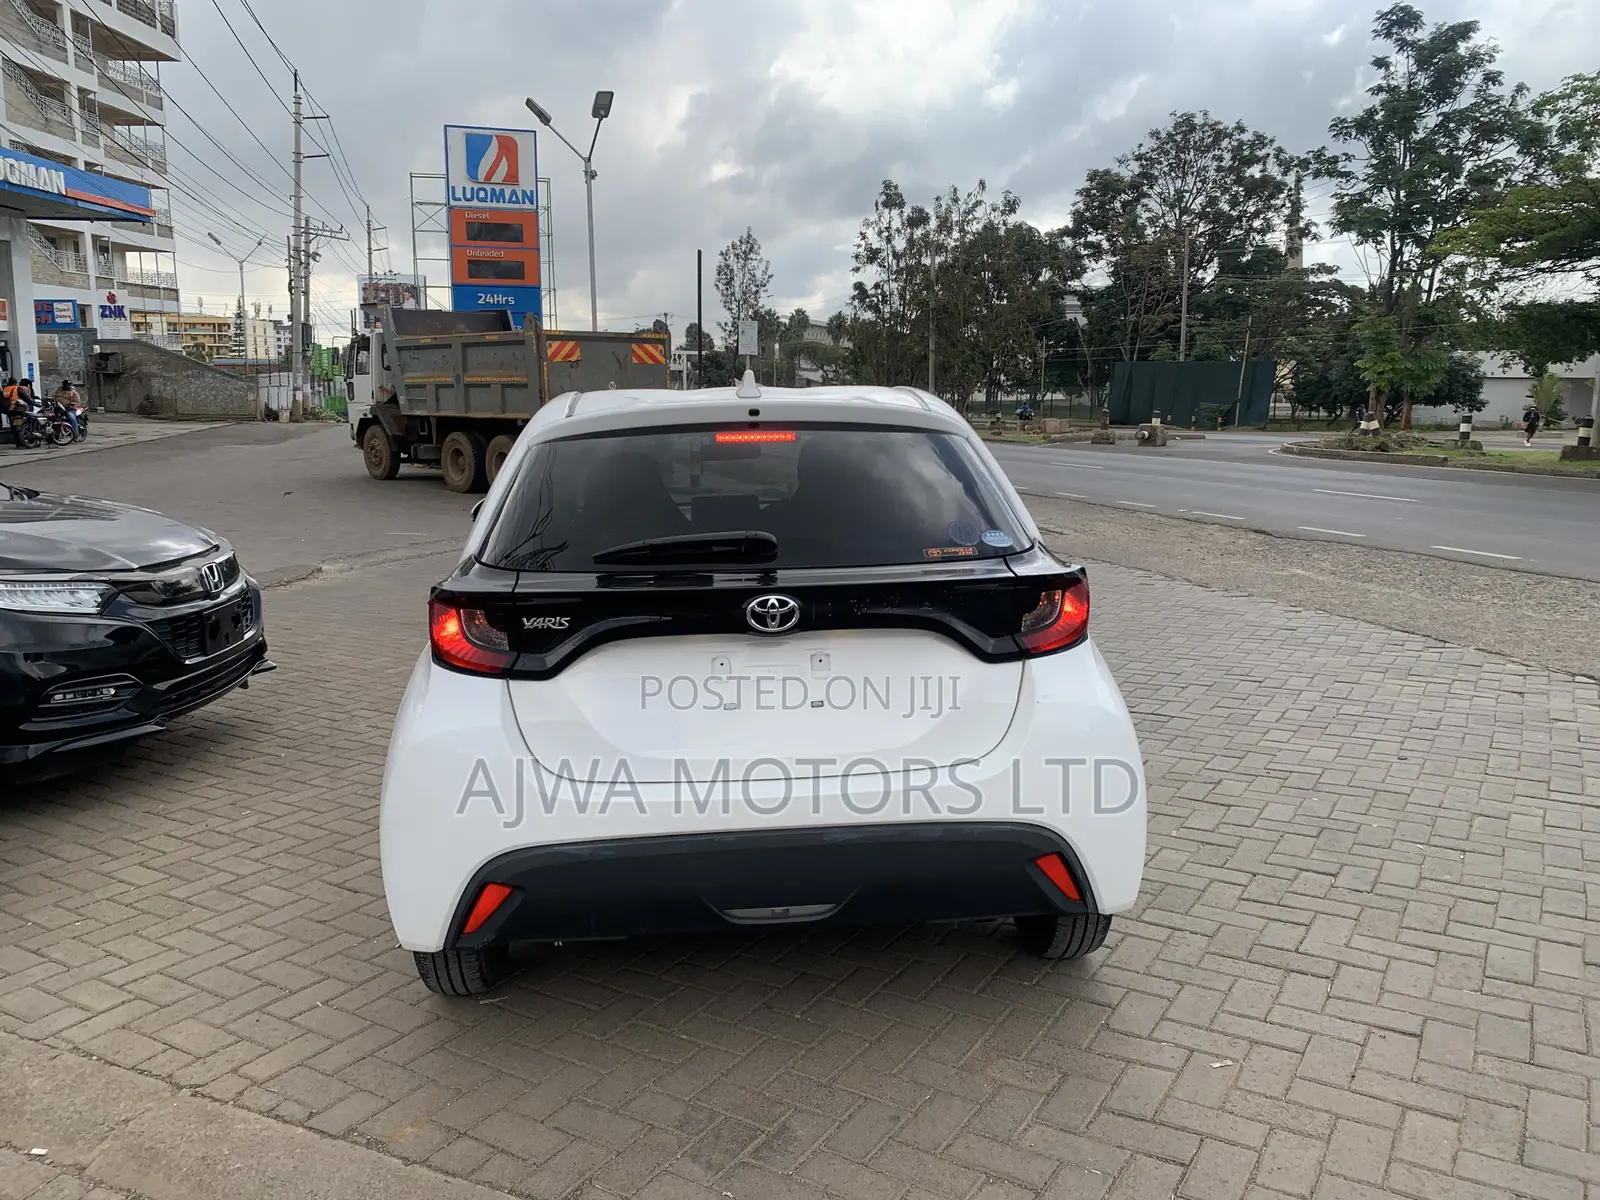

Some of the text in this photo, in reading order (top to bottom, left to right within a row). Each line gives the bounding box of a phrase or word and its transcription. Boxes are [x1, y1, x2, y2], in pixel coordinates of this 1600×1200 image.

[451, 185, 535, 205] LUQMAN
[465, 211, 490, 220] Diesel
[466, 249, 504, 258] Unleaded
[477, 293, 515, 305] 24Hrs
[99, 305, 127, 318] ZNK
[521, 616, 571, 629] YARIS
